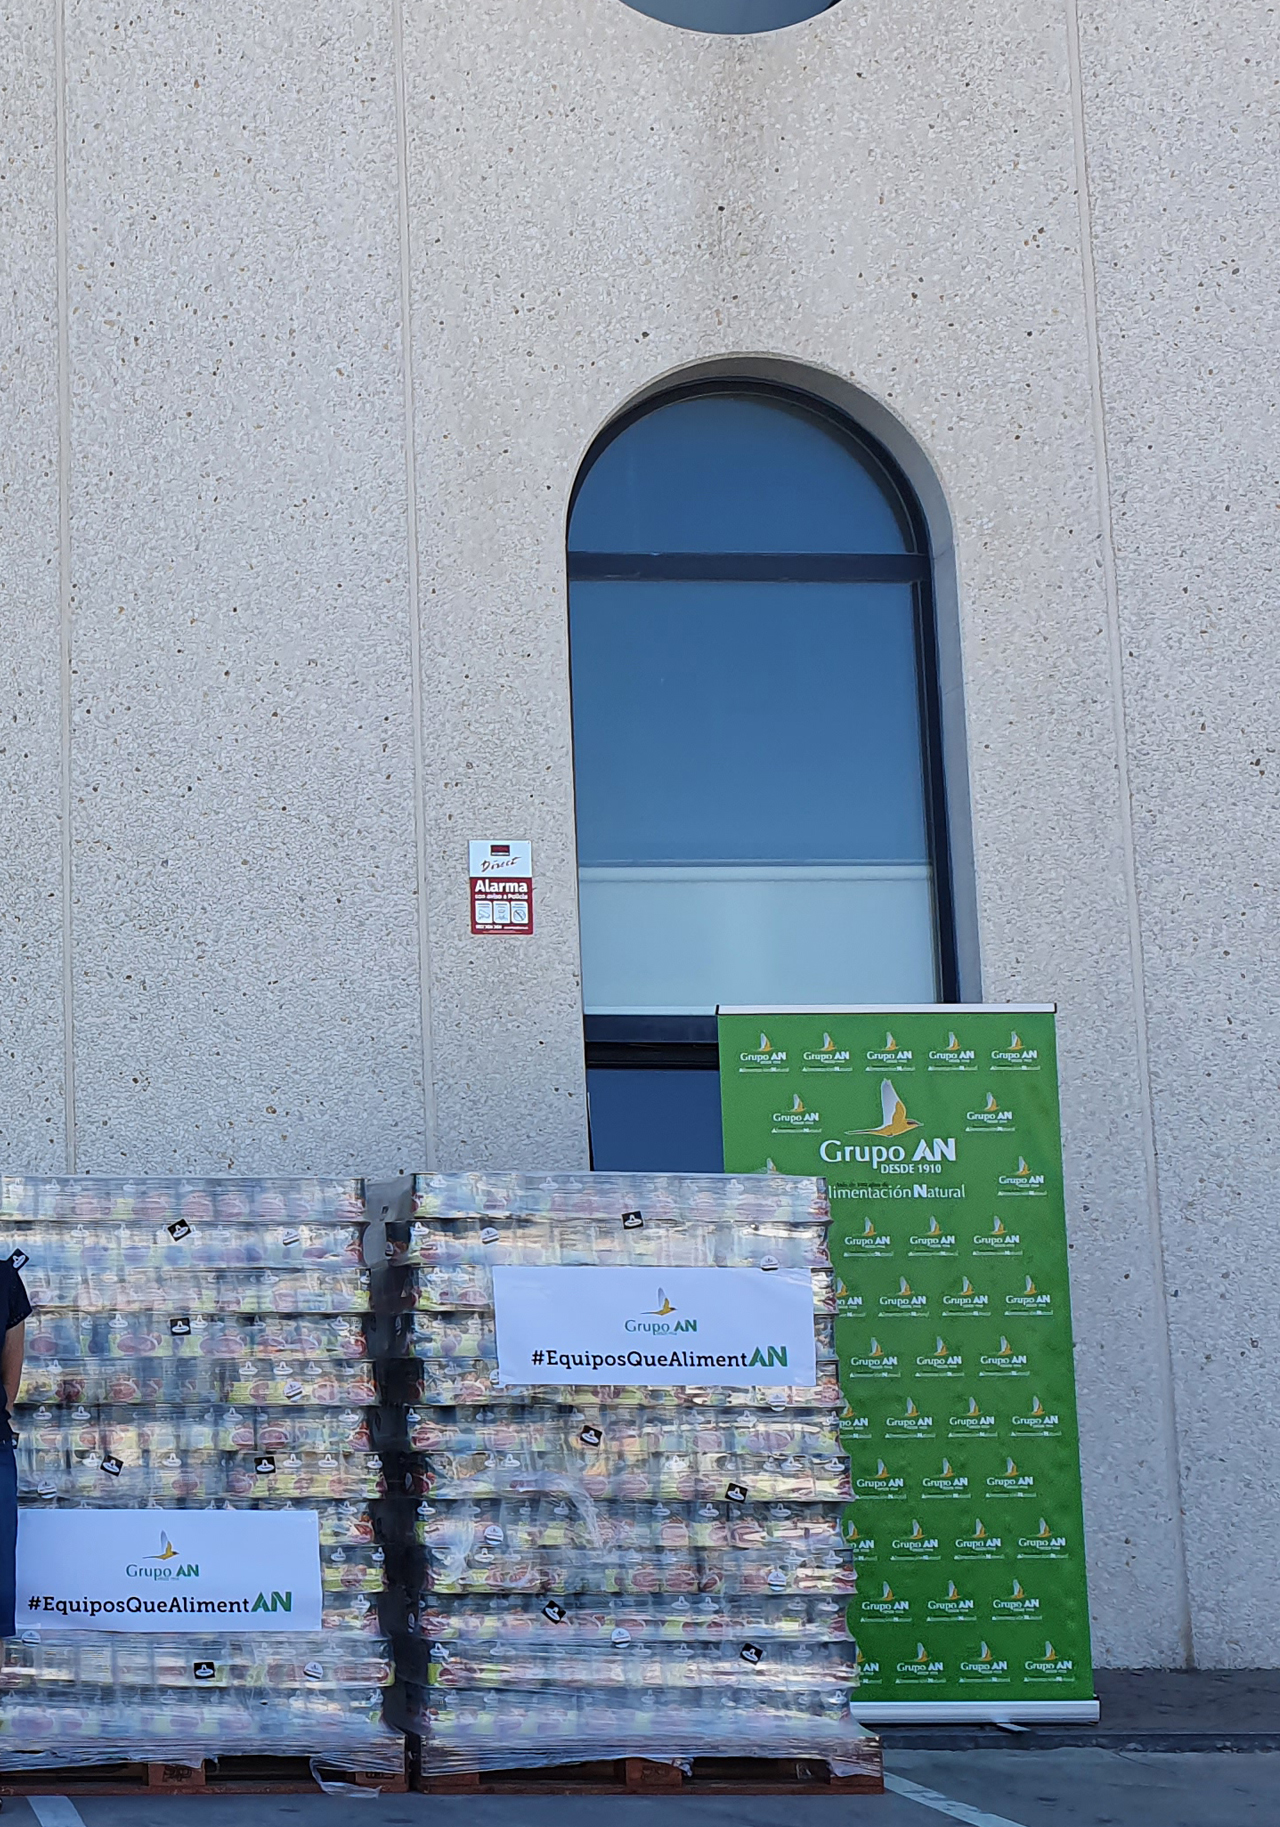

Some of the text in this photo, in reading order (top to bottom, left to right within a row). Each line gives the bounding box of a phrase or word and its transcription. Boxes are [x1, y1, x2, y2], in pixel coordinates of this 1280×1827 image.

[475, 879, 528, 893] Alarma
[770, 1052, 786, 1062] AN
[833, 1052, 849, 1061] AN
[896, 1051, 912, 1061] AN
[958, 1051, 974, 1060] AN
[1021, 1050, 1037, 1060] AN
[803, 1113, 819, 1122] AN
[996, 1111, 1012, 1121] AN
[820, 1138, 956, 1169] Grupo AN
[881, 1164, 942, 1174] DESDE 1910
[1028, 1176, 1044, 1185] AN
[828, 1184, 965, 1199] limentación Natural
[874, 1236, 890, 1246] AN
[939, 1236, 955, 1245] AN
[1003, 1235, 1019, 1245] AN
[846, 1297, 862, 1307] AN
[910, 1297, 926, 1306] AN
[972, 1296, 988, 1305] AN
[1034, 1295, 1050, 1305] AN
[625, 1319, 697, 1336] Grupo AN
[531, 1346, 788, 1370] #EquiposQueAlimentAN
[882, 1357, 898, 1366] AN
[946, 1356, 962, 1366] AN
[1010, 1356, 1026, 1365] AN
[852, 1418, 868, 1427] AN
[916, 1417, 932, 1427] AN
[978, 1417, 994, 1426] AN
[1042, 1416, 1058, 1425] AN
[887, 1479, 903, 1489] AN
[952, 1478, 968, 1488] AN
[1017, 1477, 1033, 1487] AN
[858, 1540, 874, 1549] AN
[922, 1540, 938, 1549] AN
[985, 1538, 1001, 1548] AN
[1050, 1538, 1066, 1548] AN
[126, 1564, 200, 1580] Grupo AN
[28, 1591, 292, 1616] #EquiposQueAlimentAN
[893, 1601, 909, 1611] AN
[958, 1601, 974, 1610] AN
[1023, 1600, 1039, 1609] AN
[863, 1663, 879, 1672] AN
[927, 1662, 943, 1672] AN
[991, 1662, 1007, 1671] AN
[1056, 1661, 1072, 1671] AN
